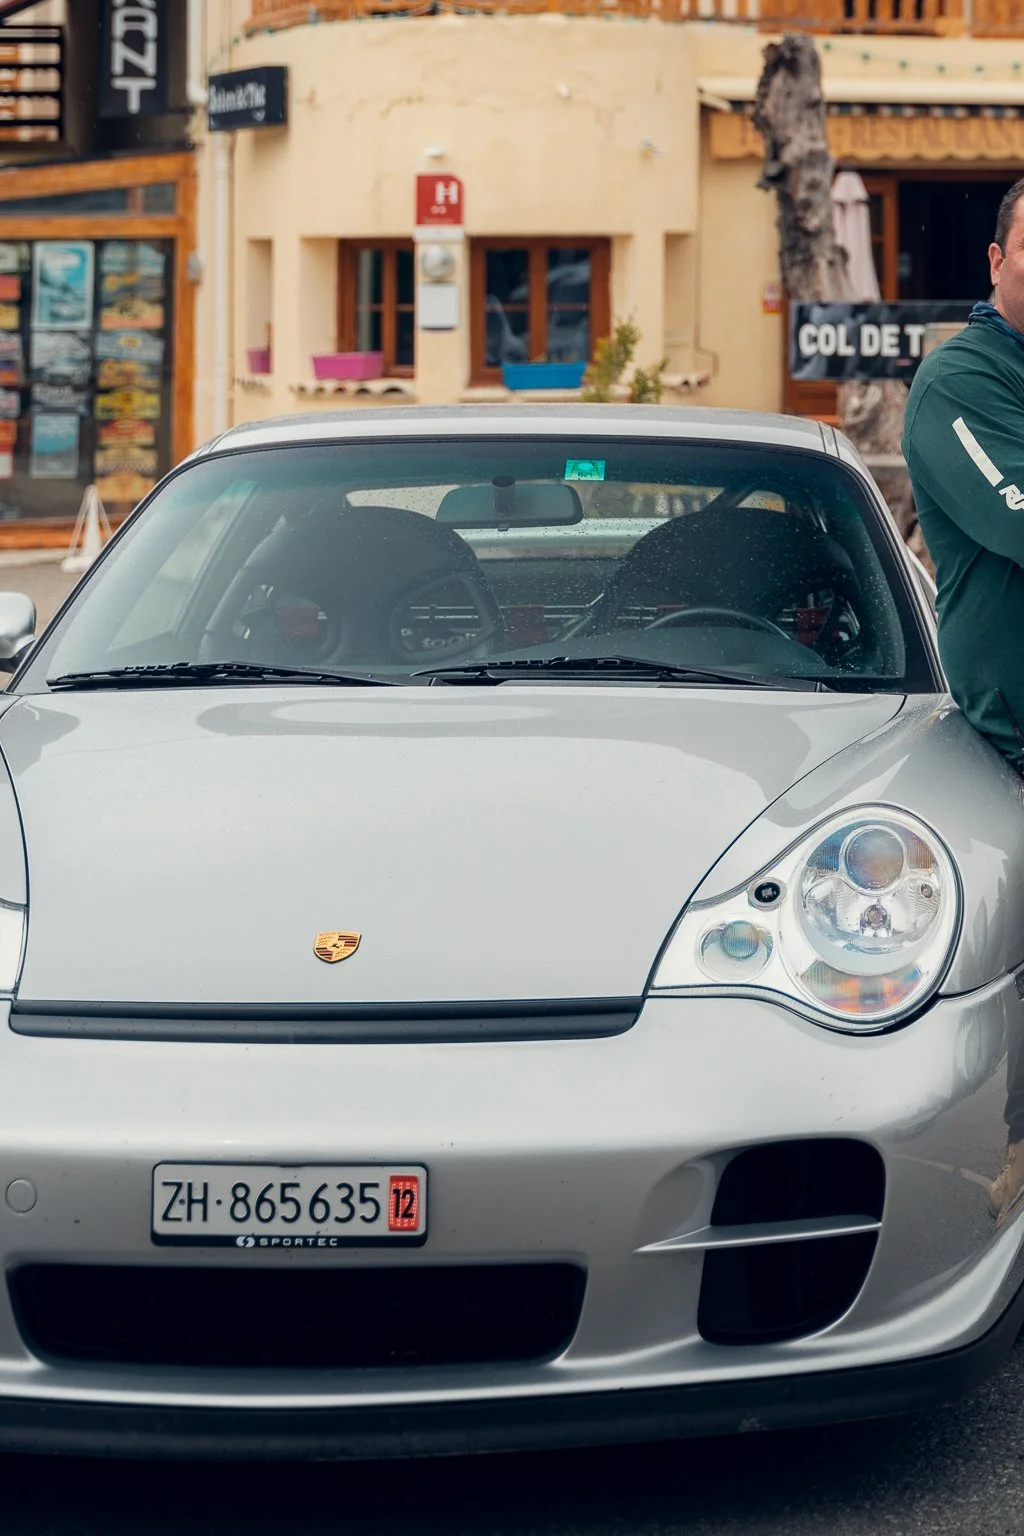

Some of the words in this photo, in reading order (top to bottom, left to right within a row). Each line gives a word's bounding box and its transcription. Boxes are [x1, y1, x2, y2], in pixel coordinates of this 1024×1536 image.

[435, 180, 459, 206] H
[799, 323, 856, 357] COL
[860, 324, 901, 358] DE
[904, 324, 927, 358] T
[392, 1188, 415, 1219] 12
[259, 1236, 339, 1247] SPORTEC
